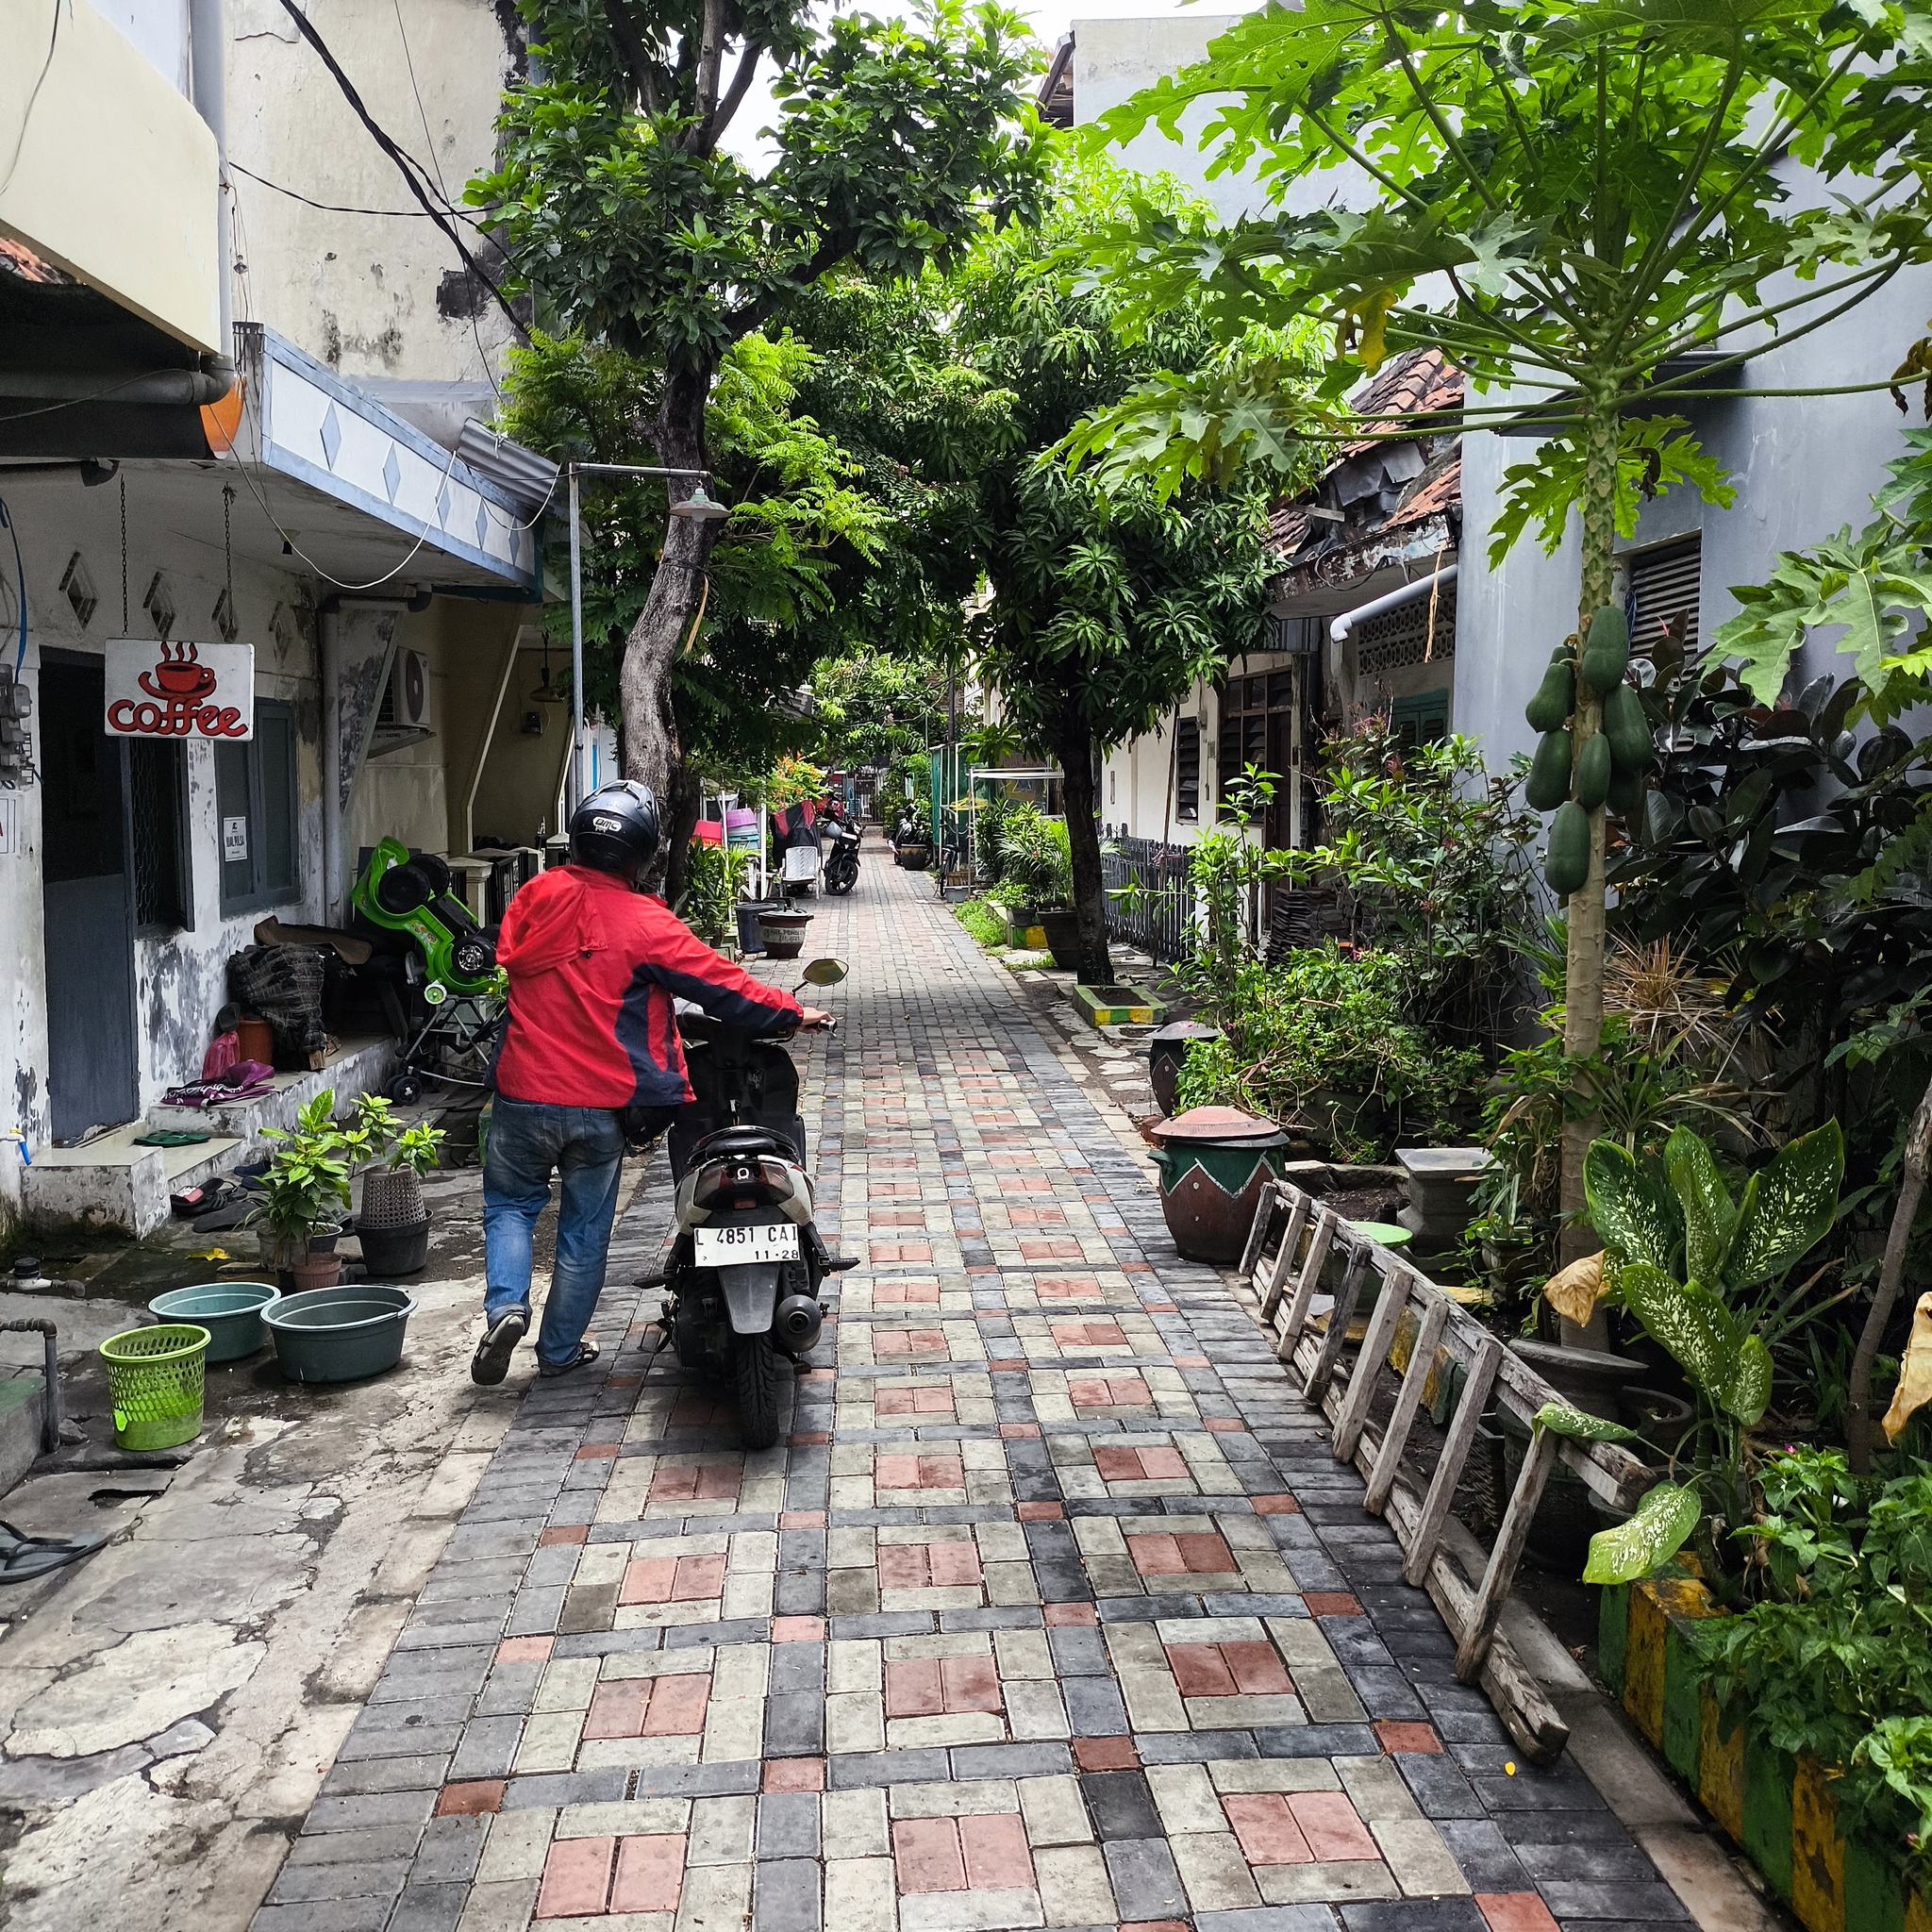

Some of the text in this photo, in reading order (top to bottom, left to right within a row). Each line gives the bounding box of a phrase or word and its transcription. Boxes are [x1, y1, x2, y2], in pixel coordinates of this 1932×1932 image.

[108, 696, 249, 737] coffee
[694, 1226, 796, 1245] L 4851 CAI
